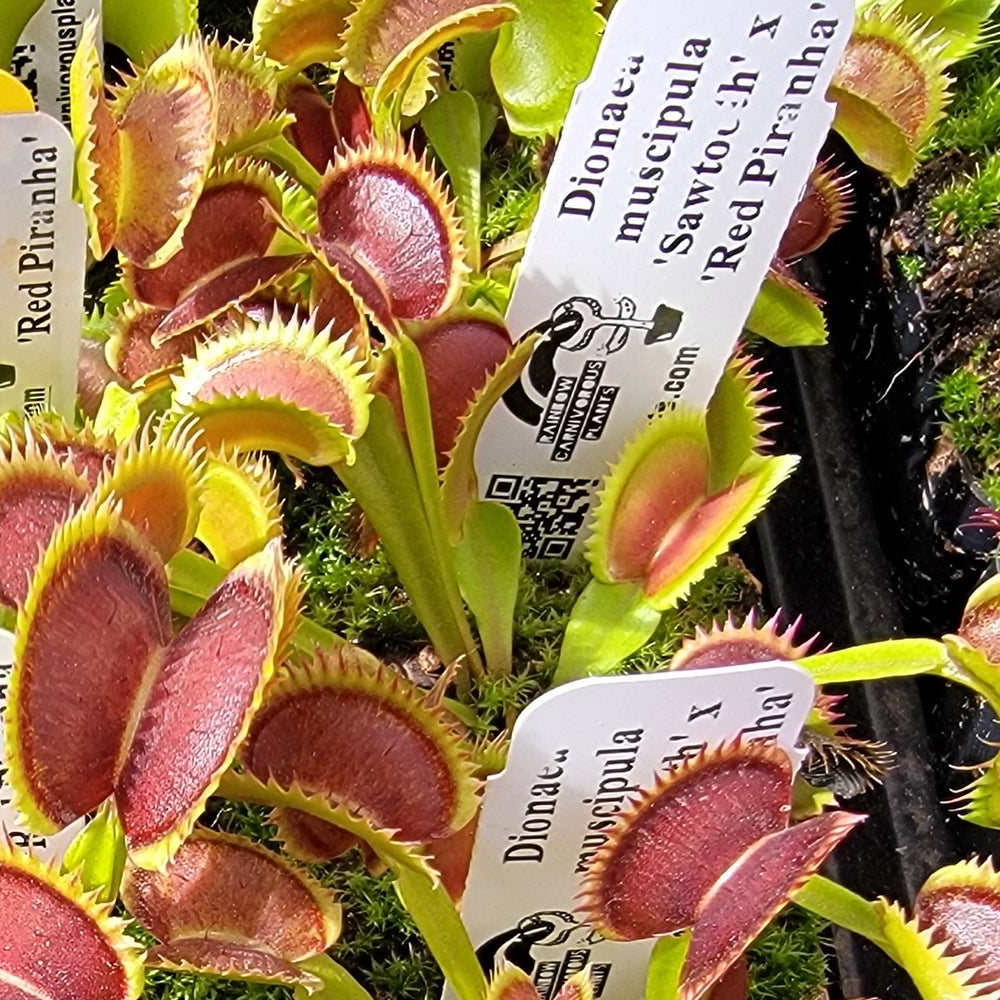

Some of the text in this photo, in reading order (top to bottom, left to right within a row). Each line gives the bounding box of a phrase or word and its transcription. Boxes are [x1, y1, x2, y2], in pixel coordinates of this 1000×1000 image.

[615, 37, 712, 244] muscipula
[700, 2, 839, 281] 'Red Piranha'
[19, 136, 58, 274] Piranha'
[17, 281, 53, 343] 'Red
[538, 376, 576, 443] RAINBOW
[553, 361, 605, 461] CARNIVOROUS
[584, 387, 617, 440] PLANTS
